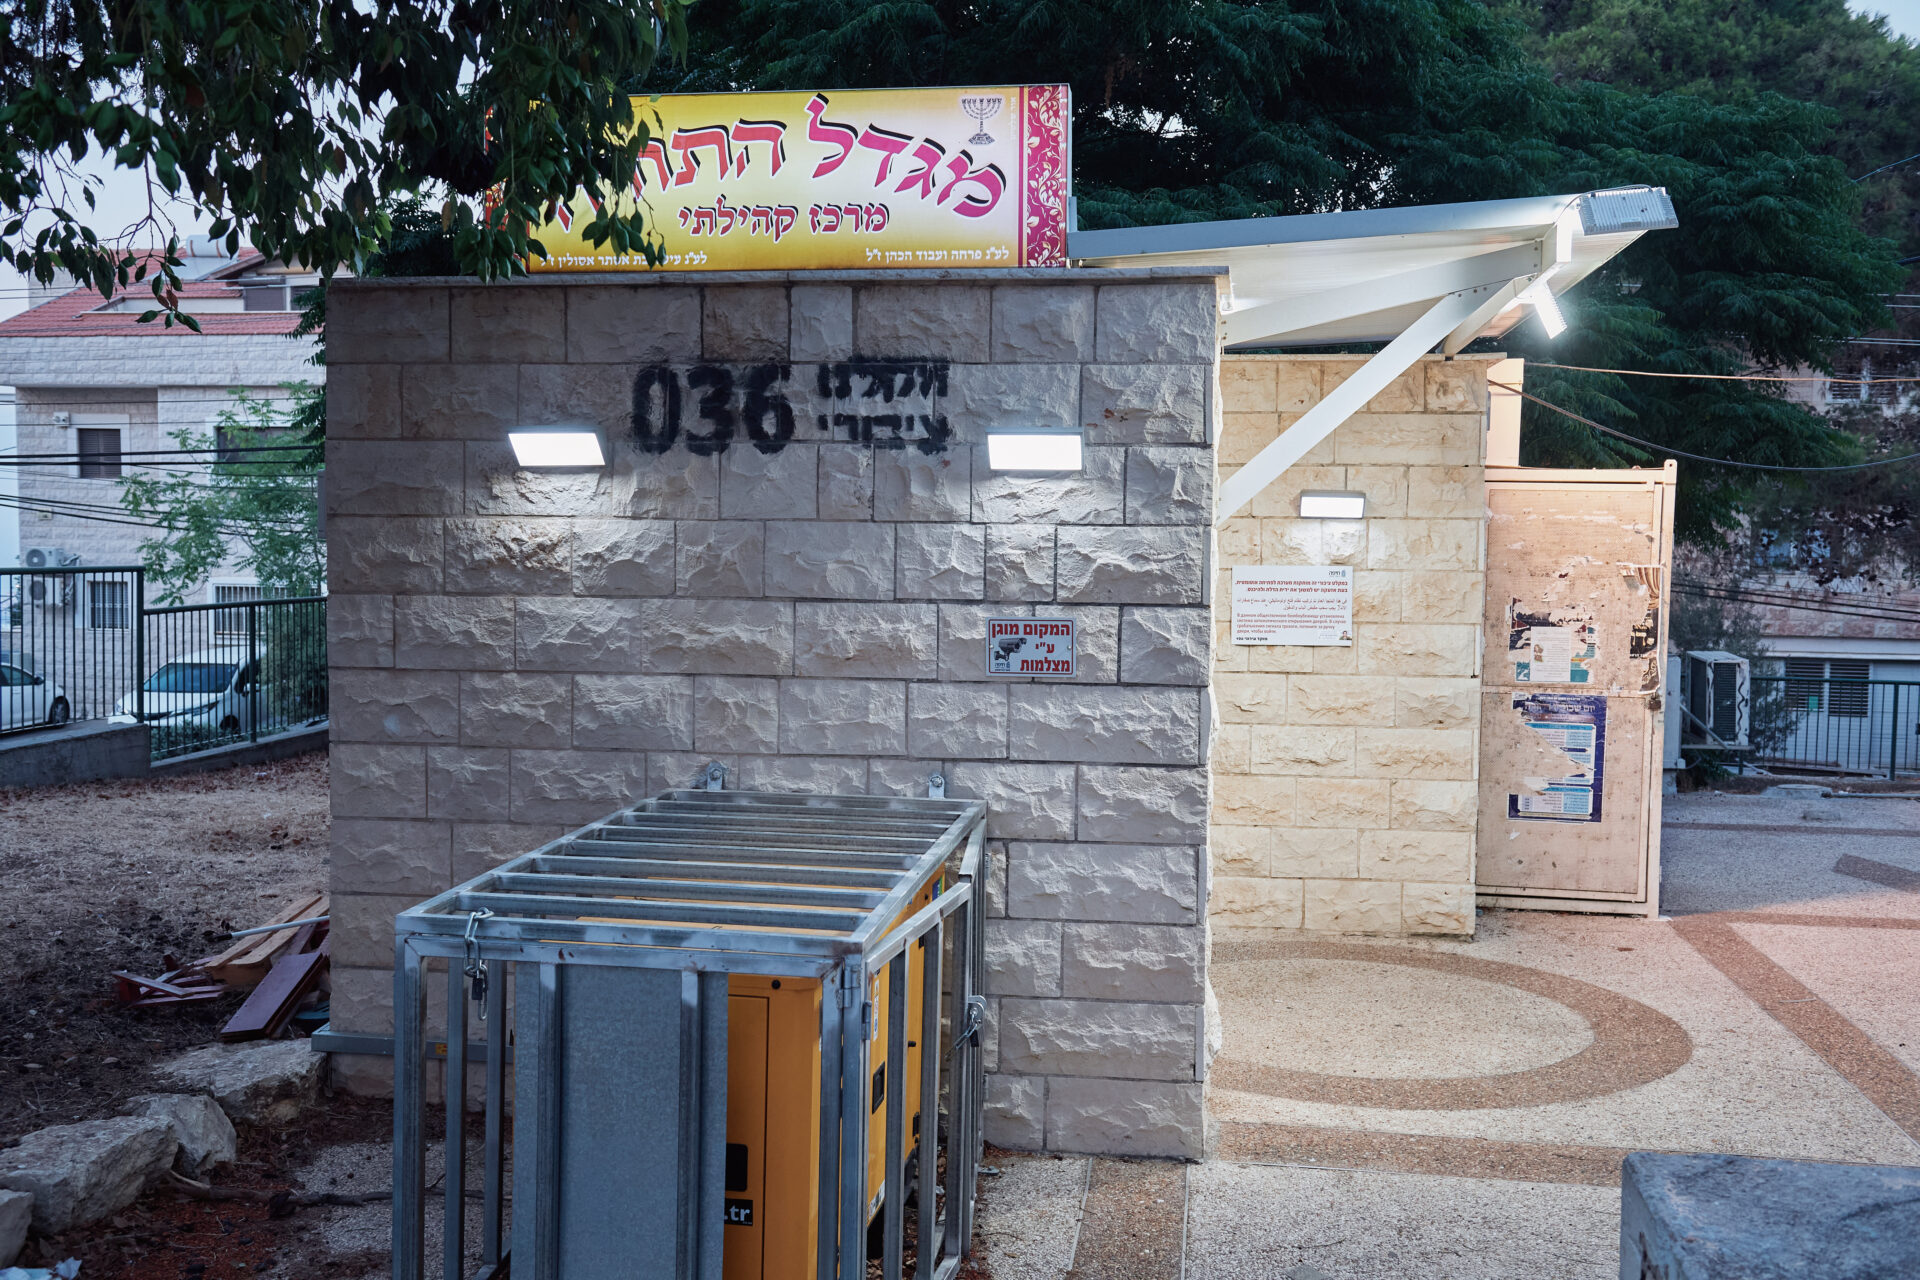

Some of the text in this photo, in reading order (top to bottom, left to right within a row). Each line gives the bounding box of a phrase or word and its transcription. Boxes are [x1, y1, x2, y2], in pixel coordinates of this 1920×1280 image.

[805, 93, 1006, 218] מגדל
[678, 194, 889, 242] מרכז קהילתי
[558, 252, 595, 268] אסולין
[885, 250, 912, 264] הכהן
[916, 250, 947, 261] ועבוד
[951, 250, 982, 260] פרחה
[985, 245, 1009, 260] לע"נ
[632, 362, 796, 457] 036
[991, 623, 1070, 639] המקום מוגן
[1035, 642, 1055, 653] ע"י
[1020, 656, 1070, 672] מצלמות
